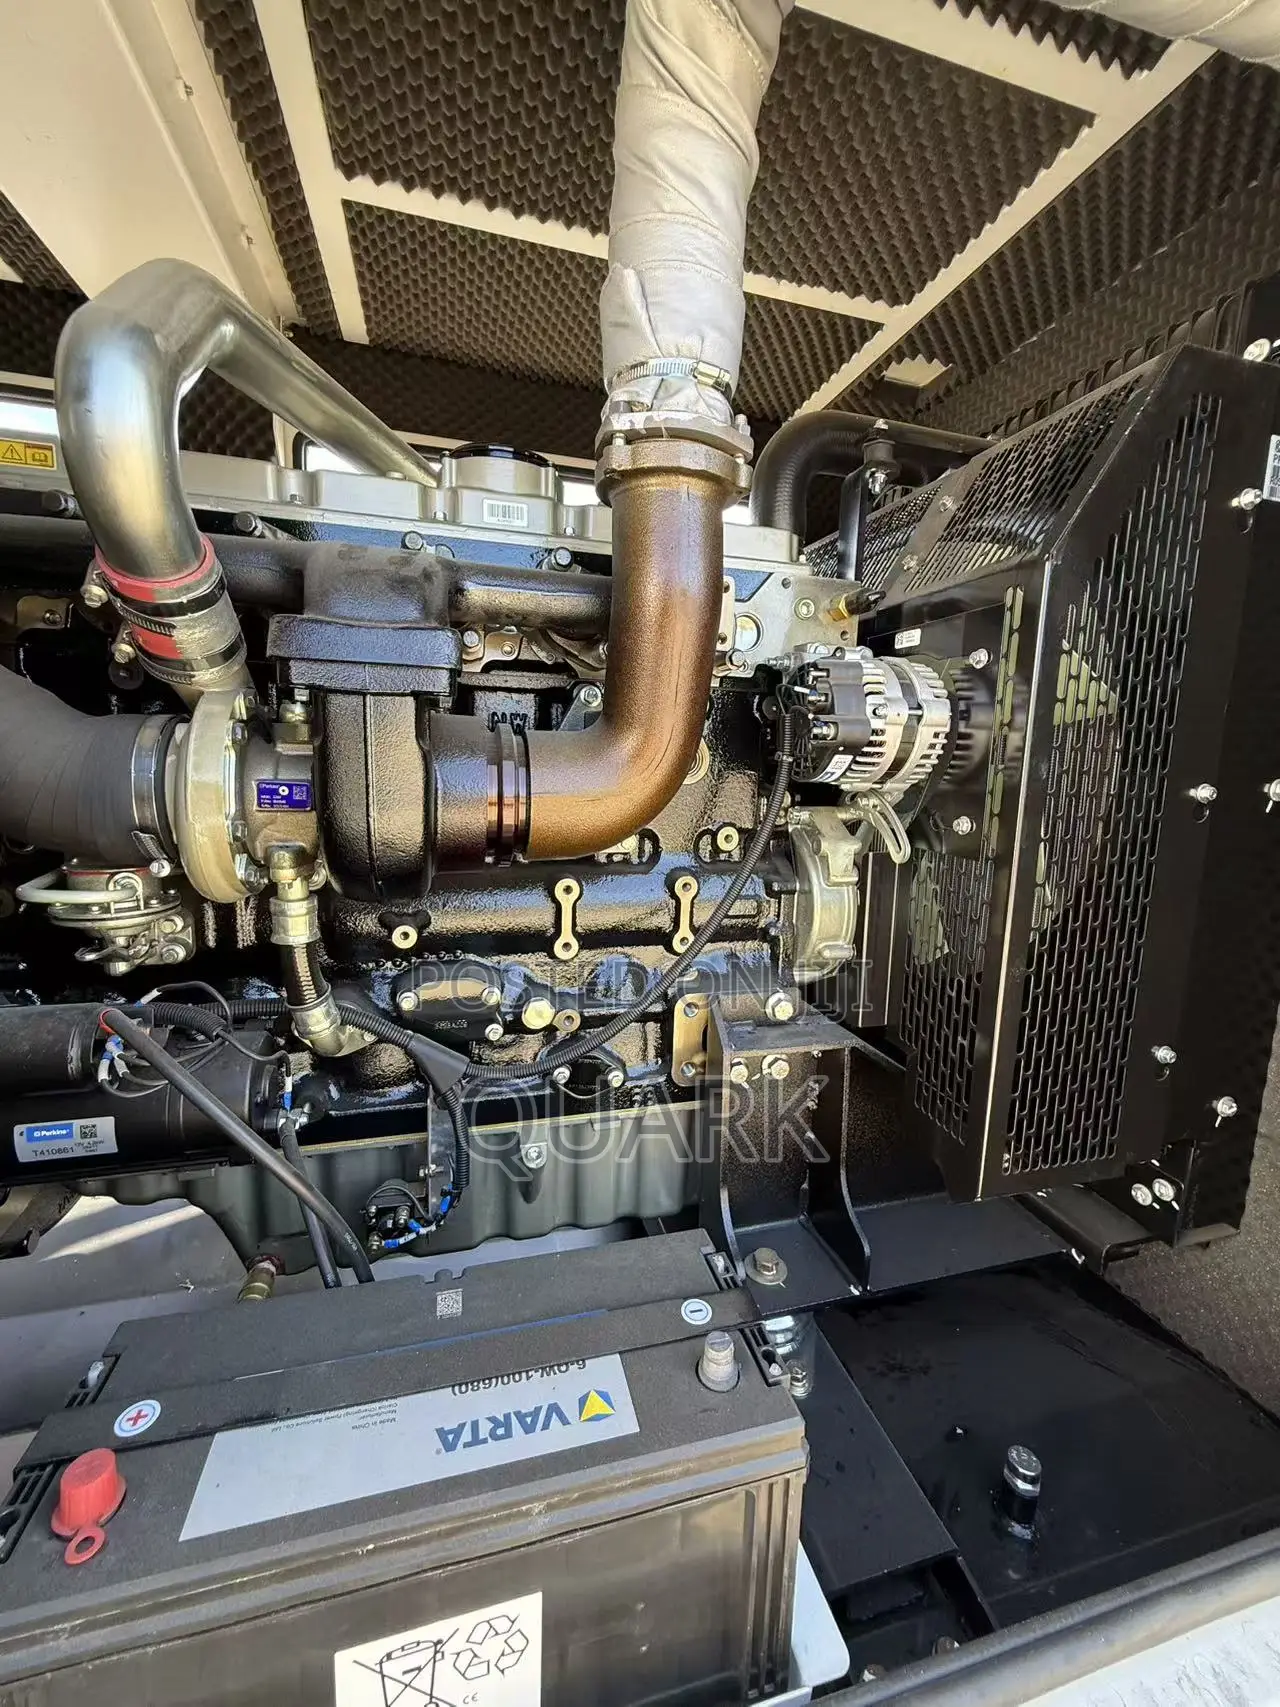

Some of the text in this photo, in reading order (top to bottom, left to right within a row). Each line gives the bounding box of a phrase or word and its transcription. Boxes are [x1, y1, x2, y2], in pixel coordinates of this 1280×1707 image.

[41, 1129, 68, 1137] Perkins
[32, 1146, 74, 1157] T410861
[379, 1417, 397, 1425] Made
[352, 1423, 370, 1431] China
[435, 1401, 571, 1453] VARTA
